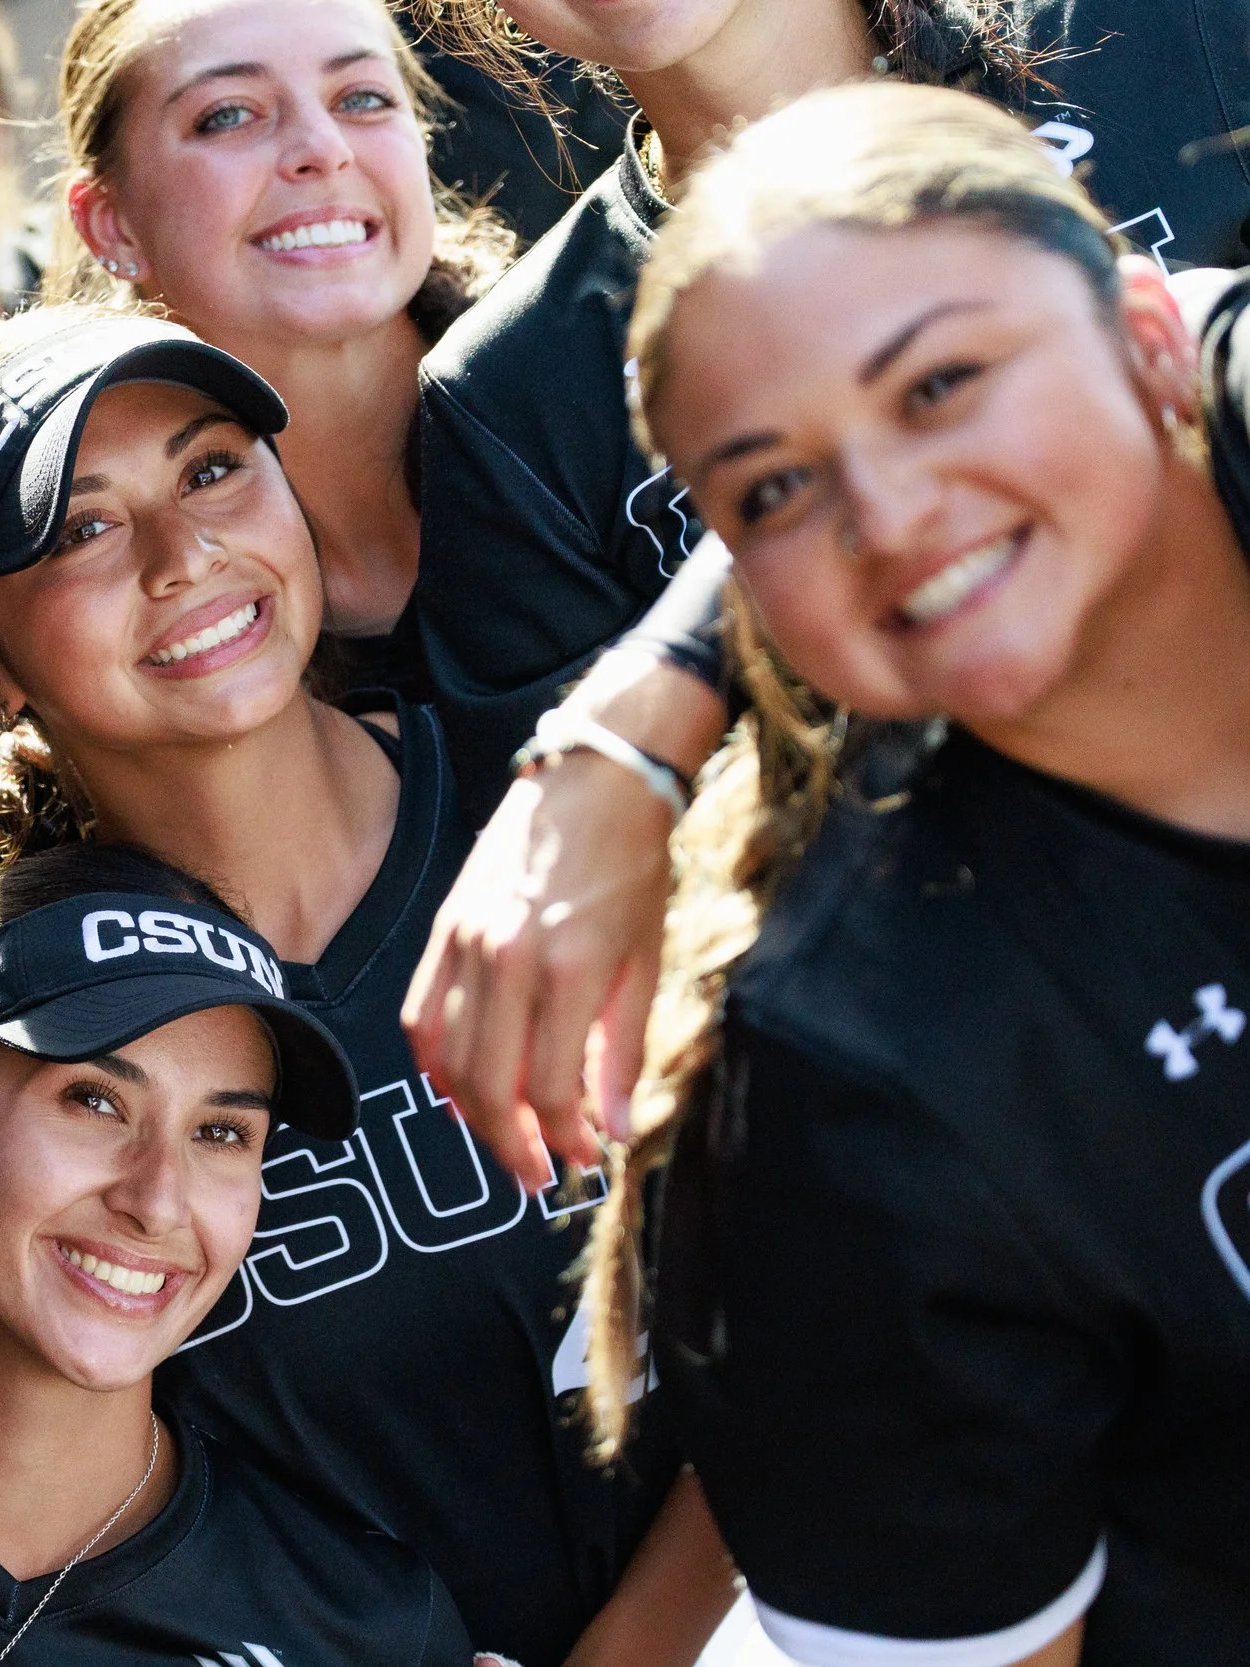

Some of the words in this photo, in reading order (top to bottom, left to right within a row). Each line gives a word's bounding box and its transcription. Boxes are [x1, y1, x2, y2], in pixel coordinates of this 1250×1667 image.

[1054, 110, 1071, 122] TM
[81, 910, 285, 1000] CSUN
[169, 1070, 609, 1357] SU
